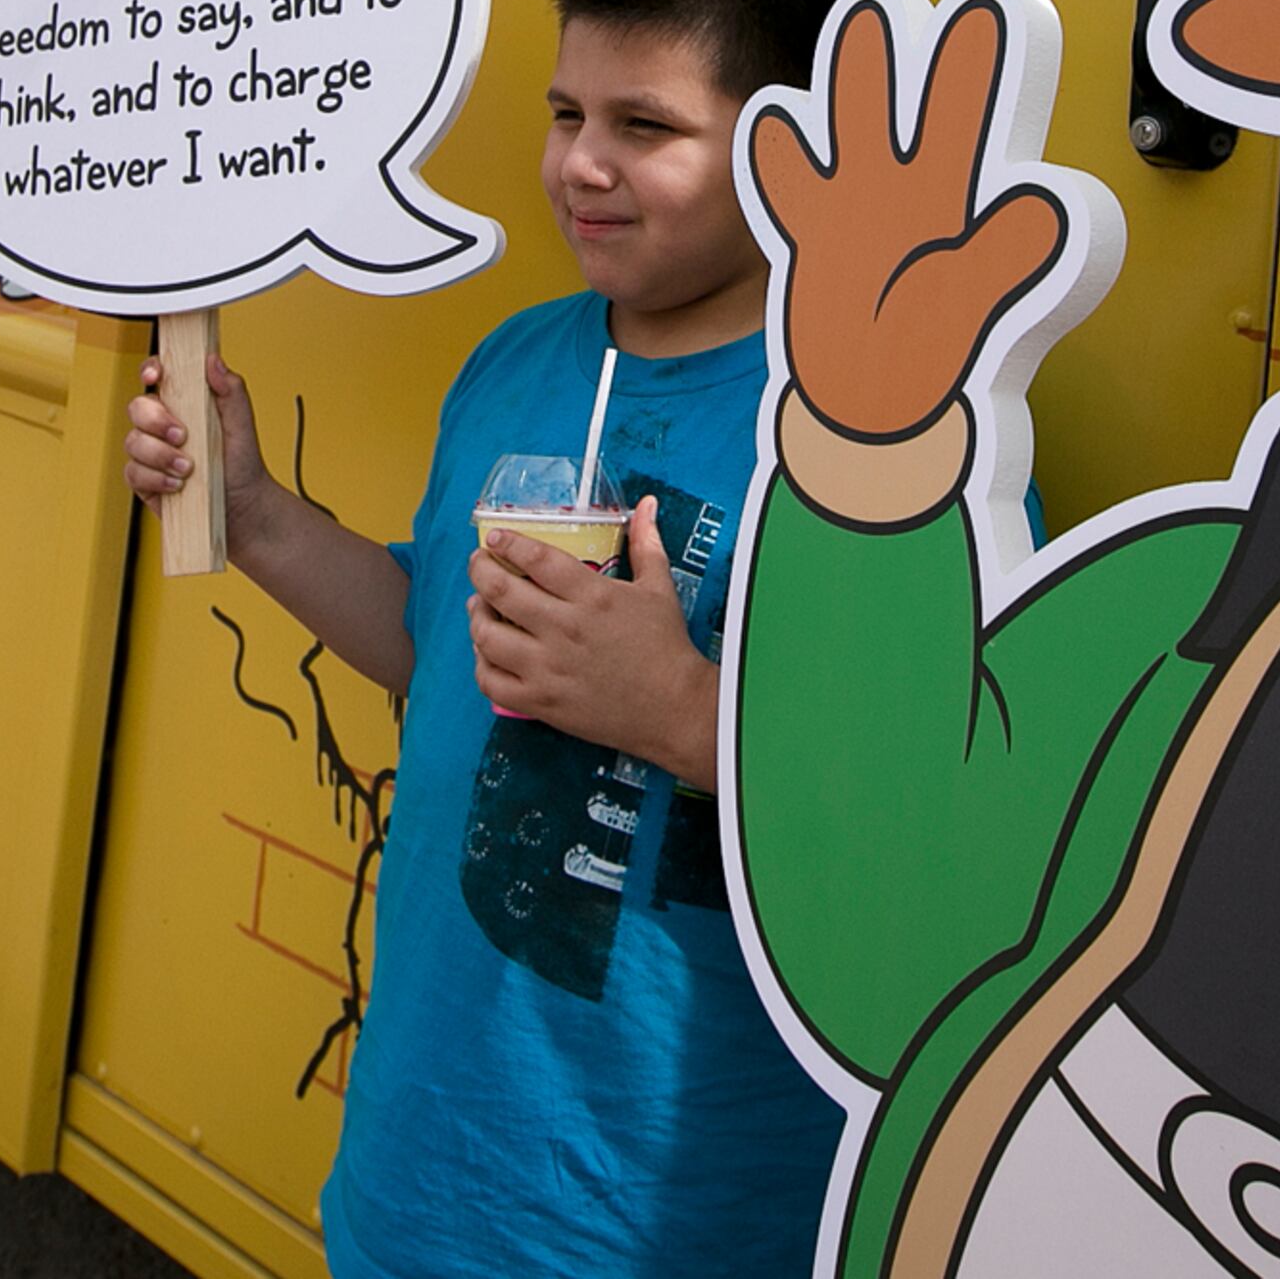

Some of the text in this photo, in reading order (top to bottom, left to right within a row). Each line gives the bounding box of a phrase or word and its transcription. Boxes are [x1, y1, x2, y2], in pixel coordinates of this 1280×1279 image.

[176, 0, 254, 52] say,
[91, 59, 160, 118] and
[172, 63, 214, 108] to
[228, 46, 373, 115] charge
[4, 126, 327, 197] whatever I want.
